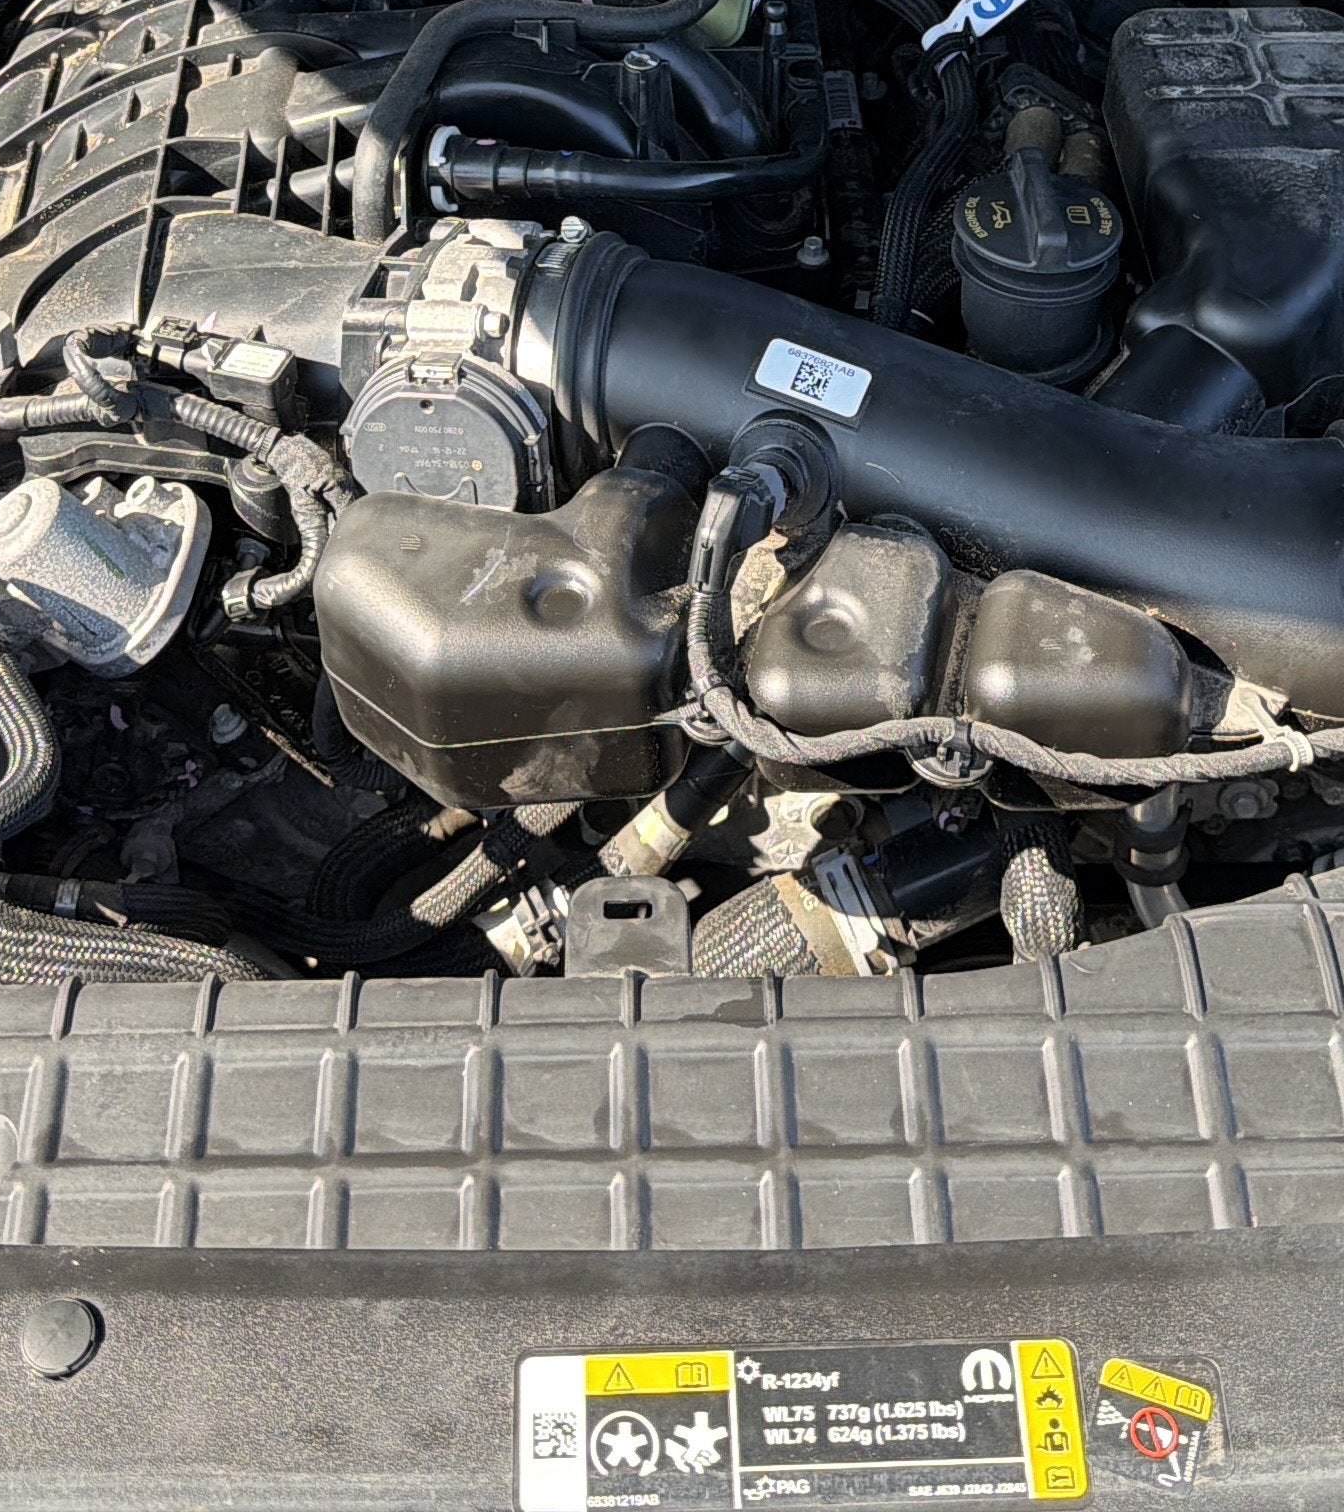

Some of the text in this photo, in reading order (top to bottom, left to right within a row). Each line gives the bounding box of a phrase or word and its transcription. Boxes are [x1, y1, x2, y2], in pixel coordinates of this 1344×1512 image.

[965, 195, 989, 239] ENGINE OIL
[1098, 219, 1113, 236] SAE
[788, 347, 855, 377] 68376821AB
[762, 1371, 840, 1392] R-1234yf
[762, 1400, 964, 1423] WL75 737g (1.625 lbs)
[763, 1422, 966, 1446] WL74 624g (1.375 lbs)
[776, 1479, 810, 1495] PAG
[909, 1485, 932, 1497] SAE
[587, 1494, 660, 1508] 68381219AB
